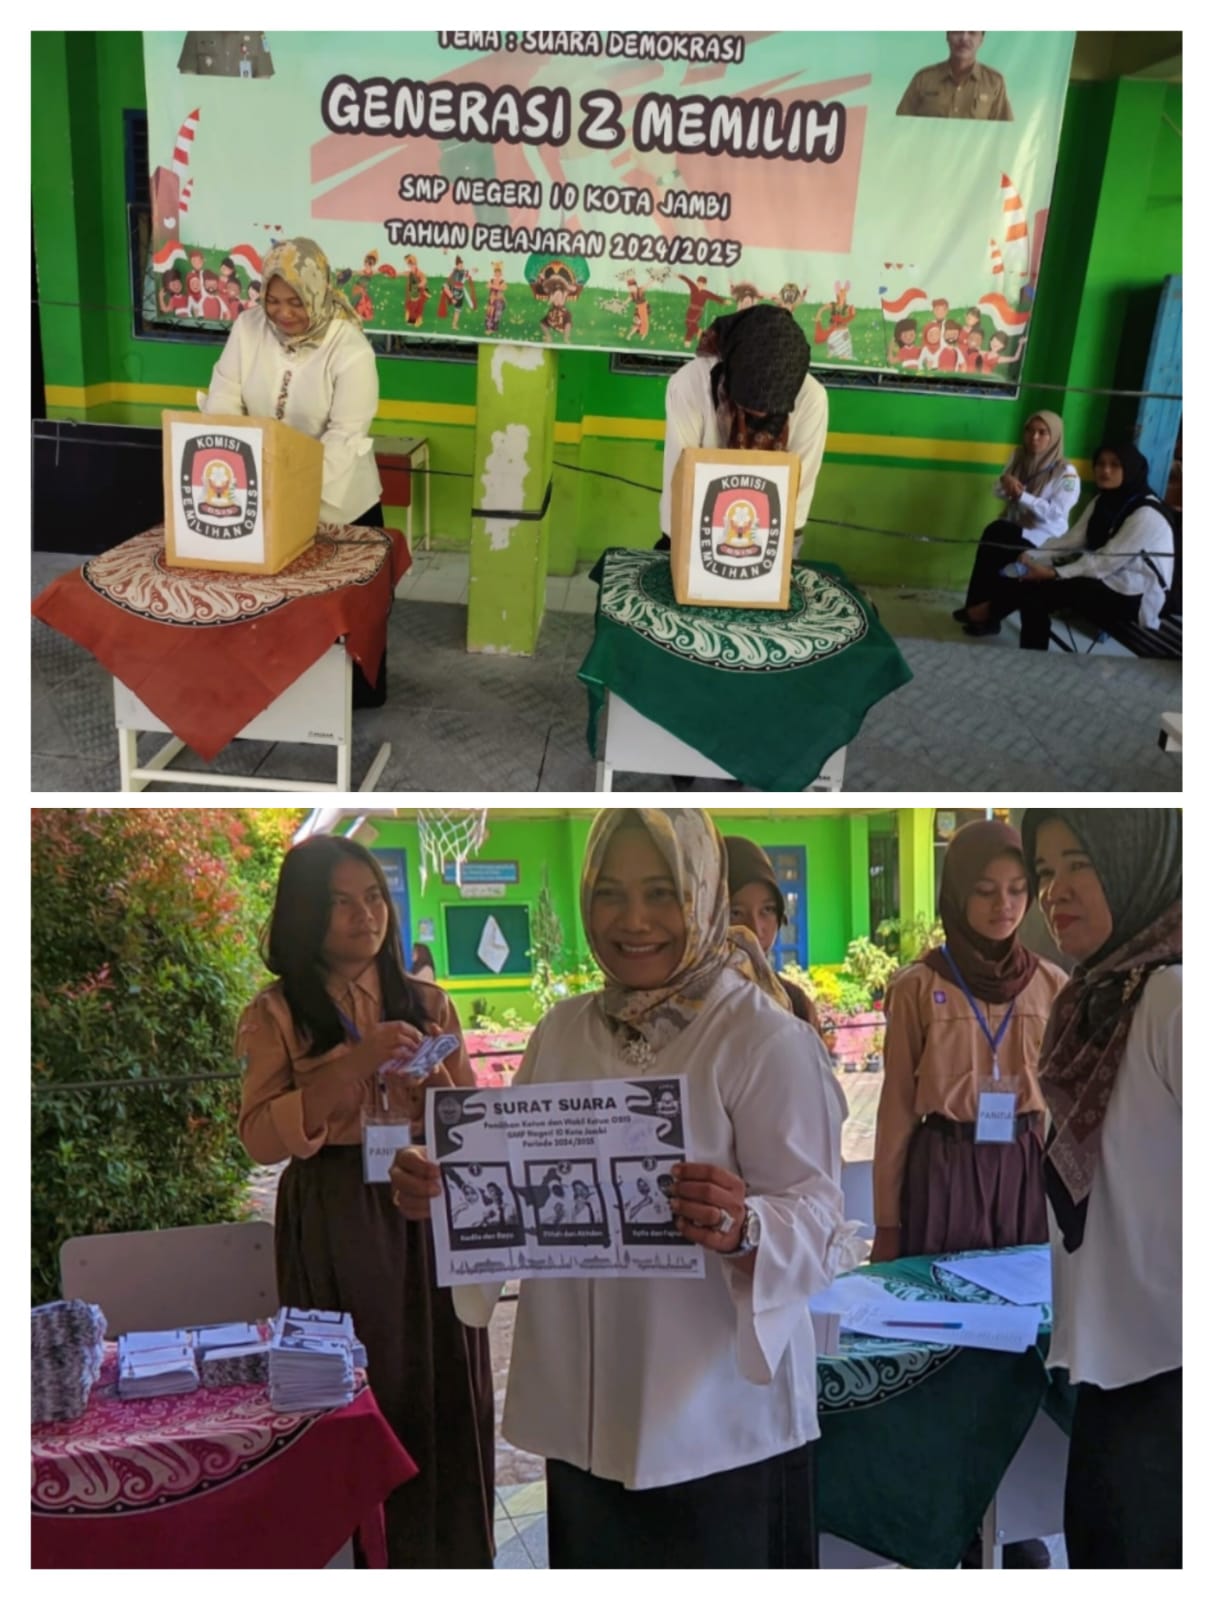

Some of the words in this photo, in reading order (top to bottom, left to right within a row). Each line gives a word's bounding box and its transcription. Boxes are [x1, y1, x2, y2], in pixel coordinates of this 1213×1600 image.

[522, 31, 601, 54] SUARA
[608, 32, 744, 61] DEMOKRASI
[325, 77, 569, 142] GENERASI
[581, 92, 623, 146] Z
[637, 95, 845, 159] MEMILIH
[400, 175, 448, 201] SMP
[454, 178, 541, 206] NEGERI
[551, 183, 578, 208] 10
[586, 185, 653, 214] KOTA
[657, 190, 729, 218] JAMBI
[386, 218, 467, 248] TAHUN
[474, 224, 604, 255] PELAJARAN
[610, 233, 740, 266] 2024/2025
[196, 436, 241, 453] KOMISI
[721, 477, 766, 491] KOMISI
[181, 486, 242, 539] PEMILIHAN
[245, 489, 258, 529] OSIS
[702, 527, 759, 578] PEMILIHAN
[764, 530, 778, 567] OSIS
[494, 1099, 553, 1115] SURAT
[558, 1097, 617, 1112] SUARA
